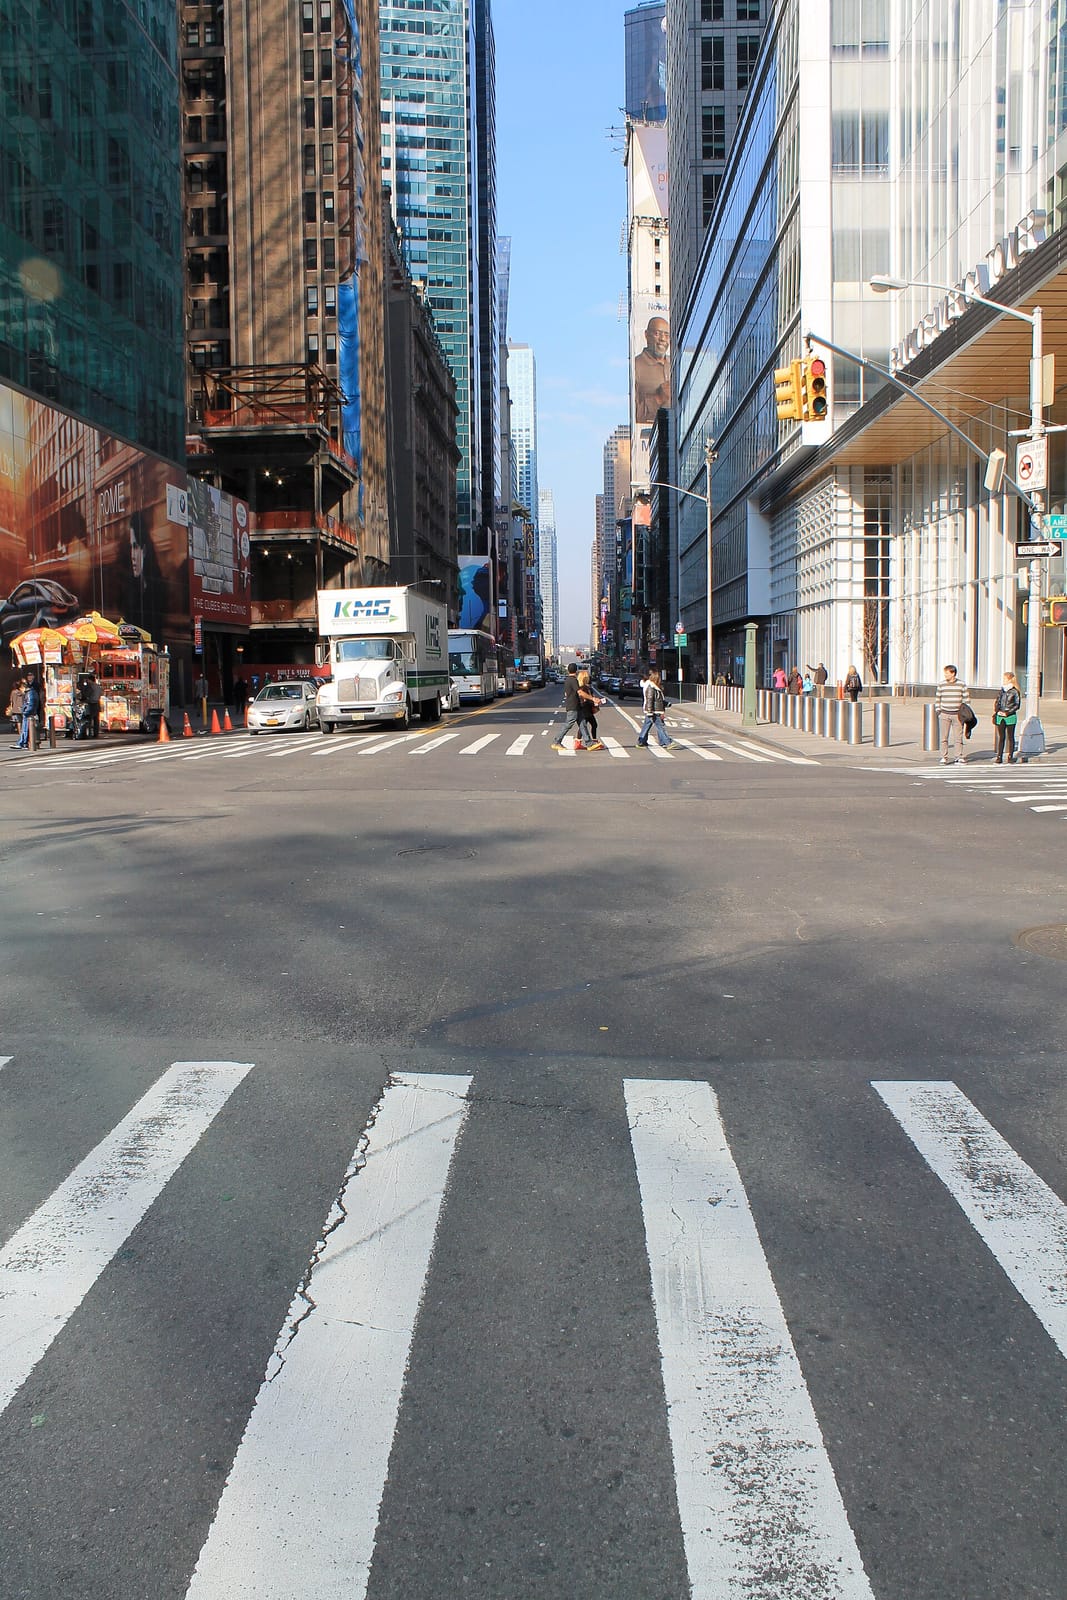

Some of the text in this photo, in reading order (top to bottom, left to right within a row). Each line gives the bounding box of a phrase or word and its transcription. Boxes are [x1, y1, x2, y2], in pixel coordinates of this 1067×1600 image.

[100, 481, 125, 514] ROME
[1054, 528, 1061, 538] 6
[526, 524, 534, 567] MADAME
[1021, 545, 1055, 554] ONE WAY
[193, 597, 204, 609] THE
[334, 599, 391, 618] KMG
